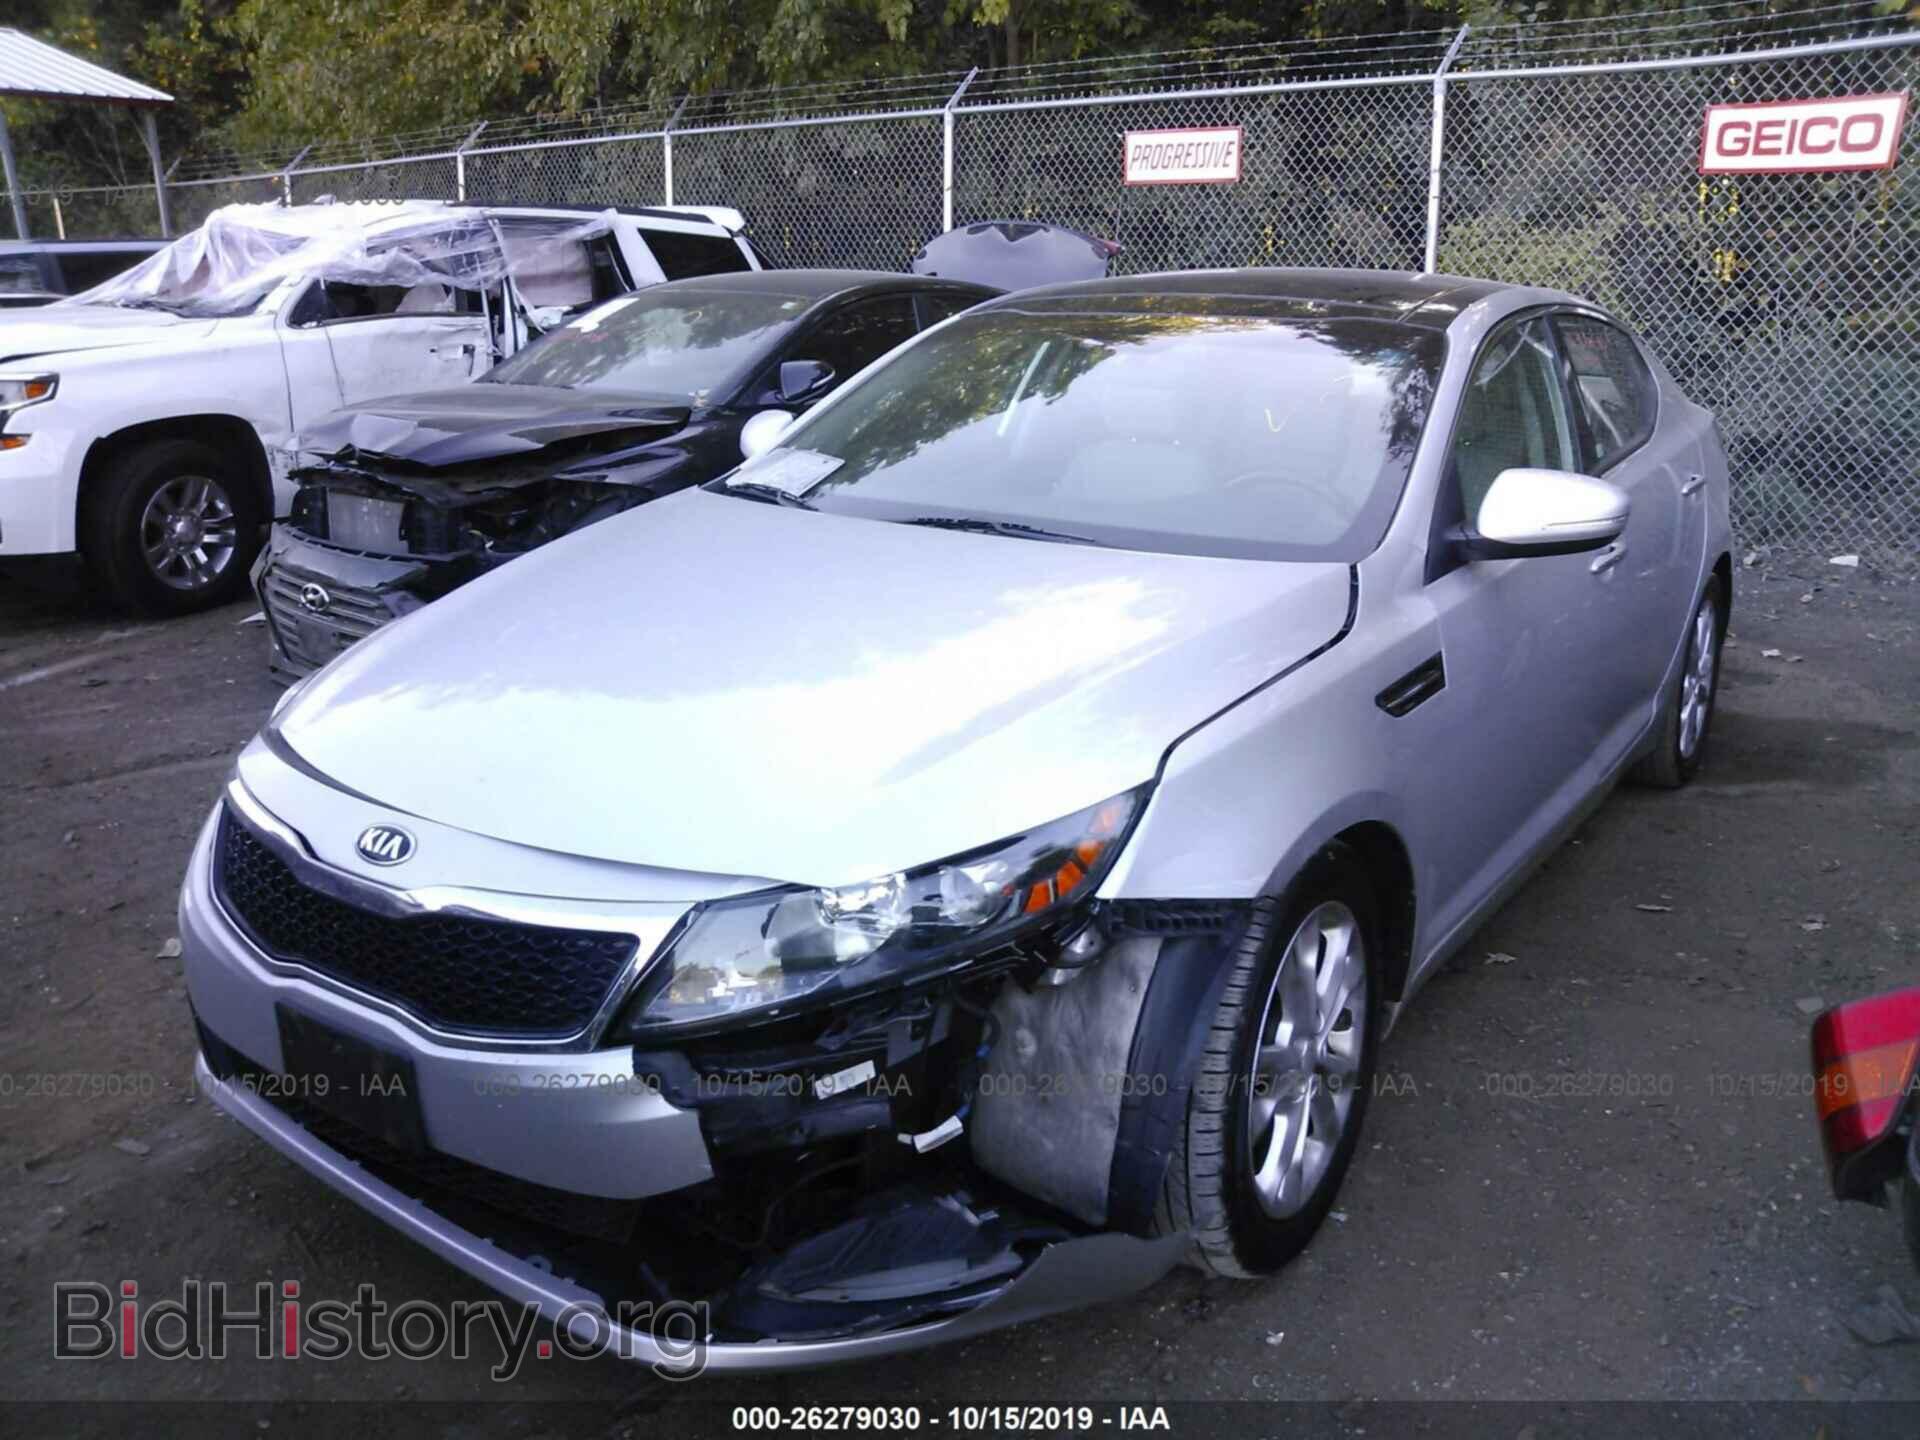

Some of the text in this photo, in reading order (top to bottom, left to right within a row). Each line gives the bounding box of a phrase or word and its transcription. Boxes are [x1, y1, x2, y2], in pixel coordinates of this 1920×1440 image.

[1716, 113, 1885, 157] GEICO
[1130, 140, 1236, 172] PROGRESSIVE
[360, 828, 404, 860] KIA
